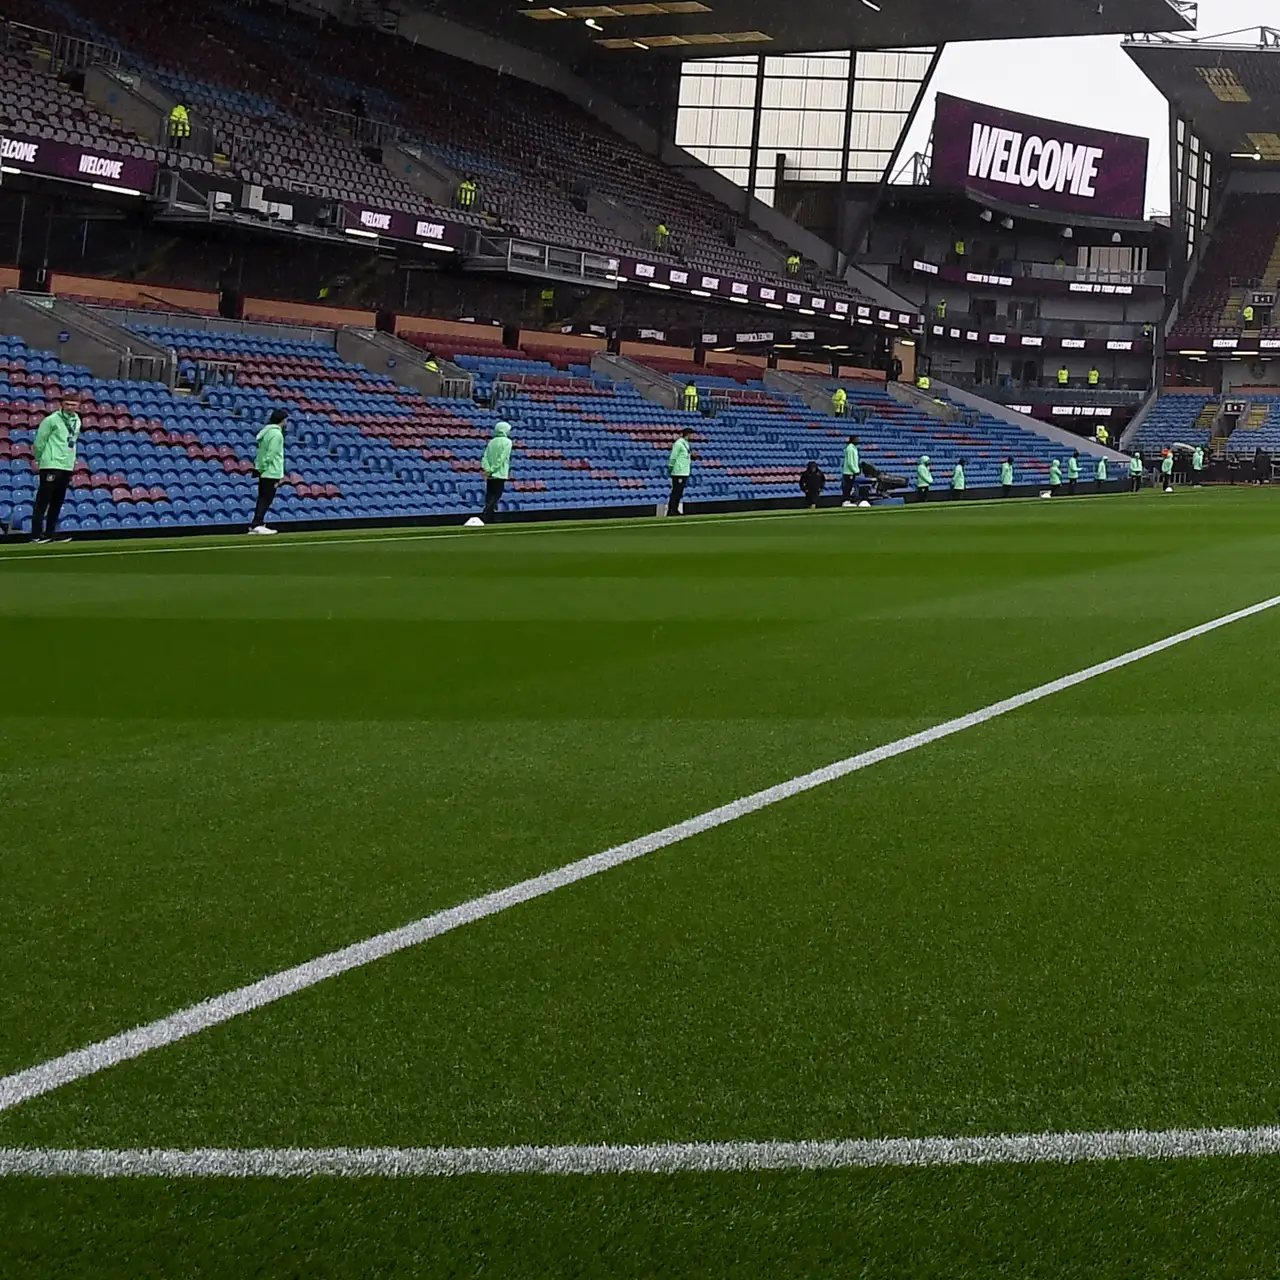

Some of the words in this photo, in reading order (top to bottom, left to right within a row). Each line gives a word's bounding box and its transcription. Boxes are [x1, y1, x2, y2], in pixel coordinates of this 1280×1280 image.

[79, 155, 123, 178] WELCOME
[969, 118, 1110, 196] WELCOME
[361, 211, 391, 229] WELCOME
[416, 222, 444, 239] WELCOME
